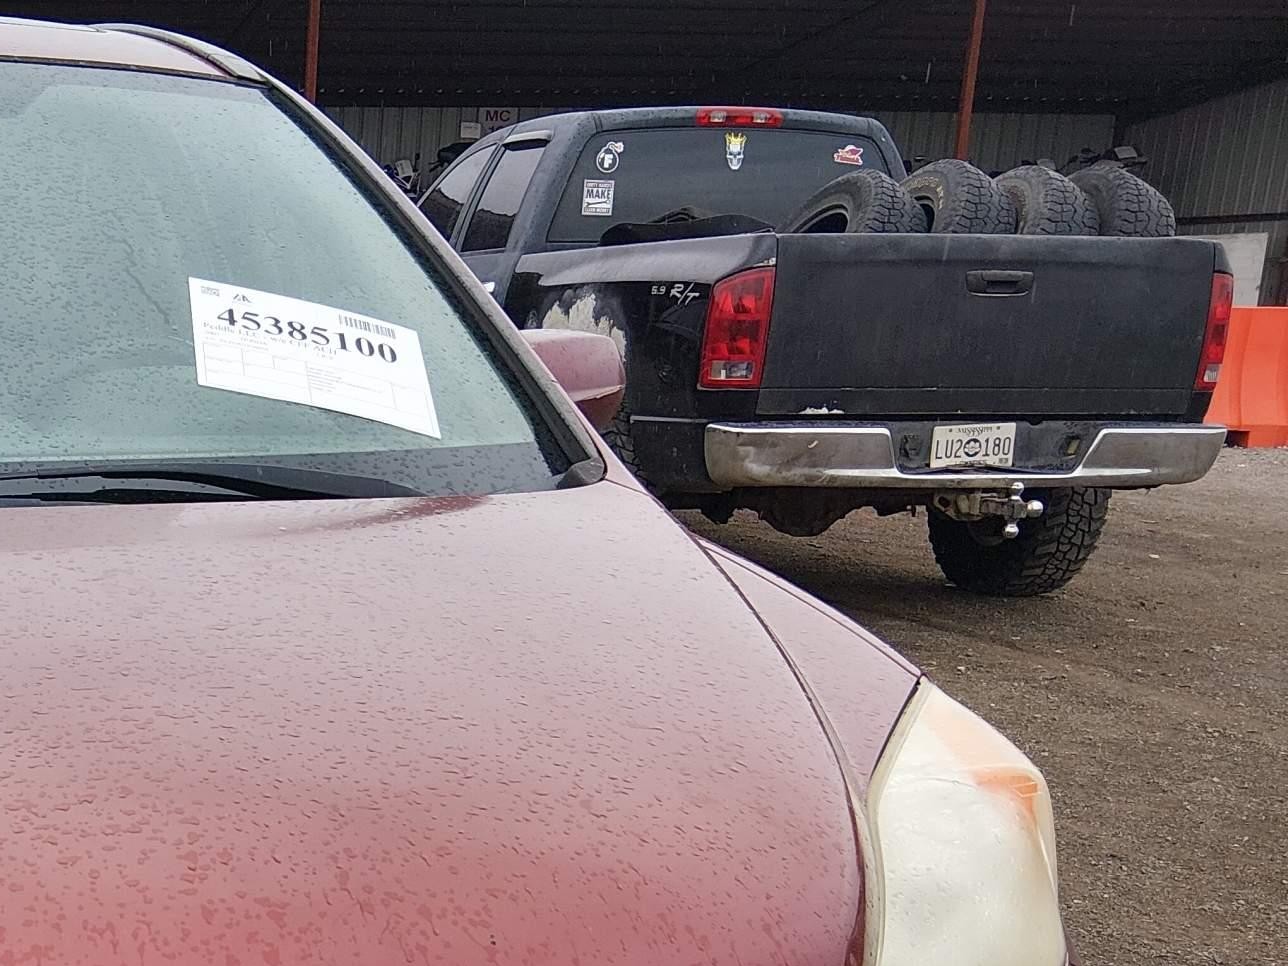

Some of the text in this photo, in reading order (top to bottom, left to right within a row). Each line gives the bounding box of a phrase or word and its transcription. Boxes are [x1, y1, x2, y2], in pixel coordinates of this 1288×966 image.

[485, 110, 511, 122] MC
[585, 188, 612, 199] MAKE
[669, 281, 700, 306] R/T
[216, 308, 398, 364] 45385100
[935, 437, 1011, 459] LU2 180
